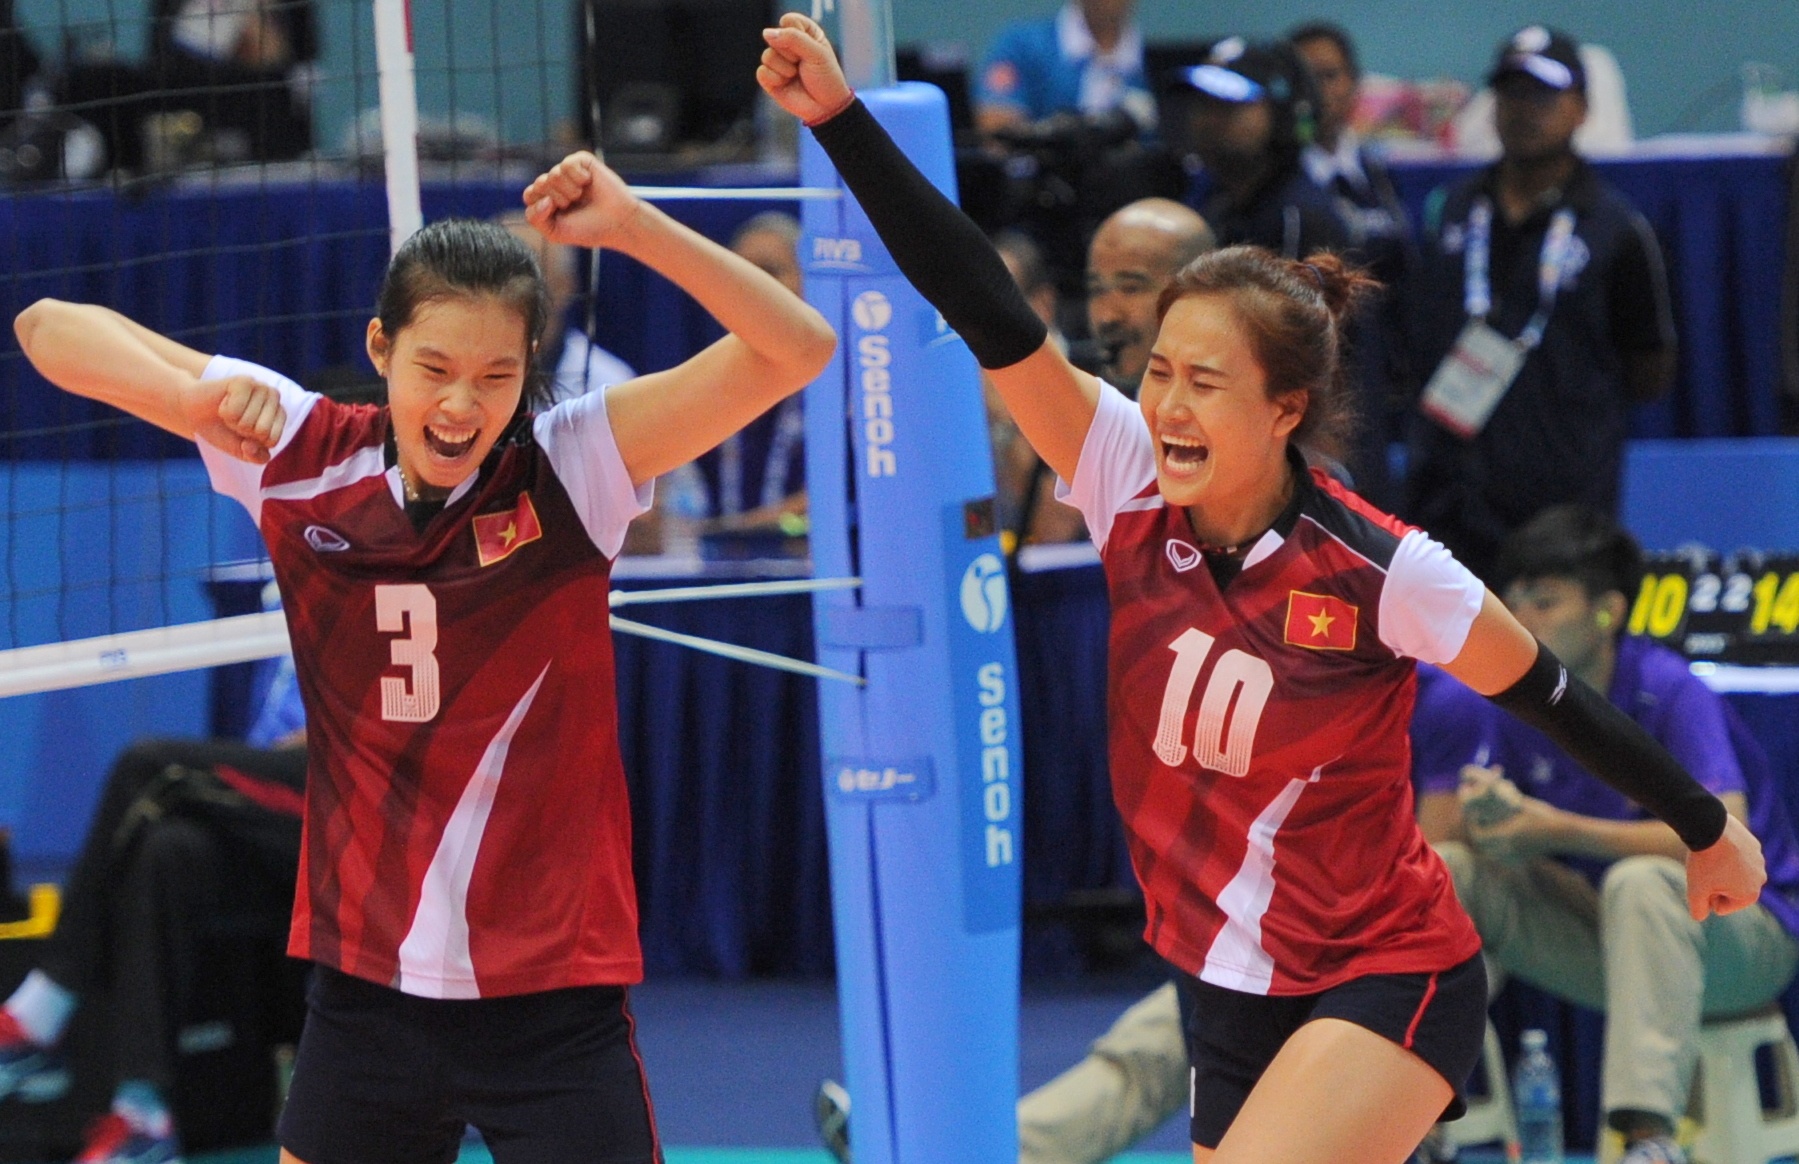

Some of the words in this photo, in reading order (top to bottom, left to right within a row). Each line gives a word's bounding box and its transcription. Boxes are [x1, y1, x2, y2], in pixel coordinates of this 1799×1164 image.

[375, 583, 441, 723] 3
[1628, 572, 1688, 637] 10
[1690, 572, 1721, 612] 2
[1721, 572, 1753, 612] 2
[1151, 626, 1275, 778] 10
